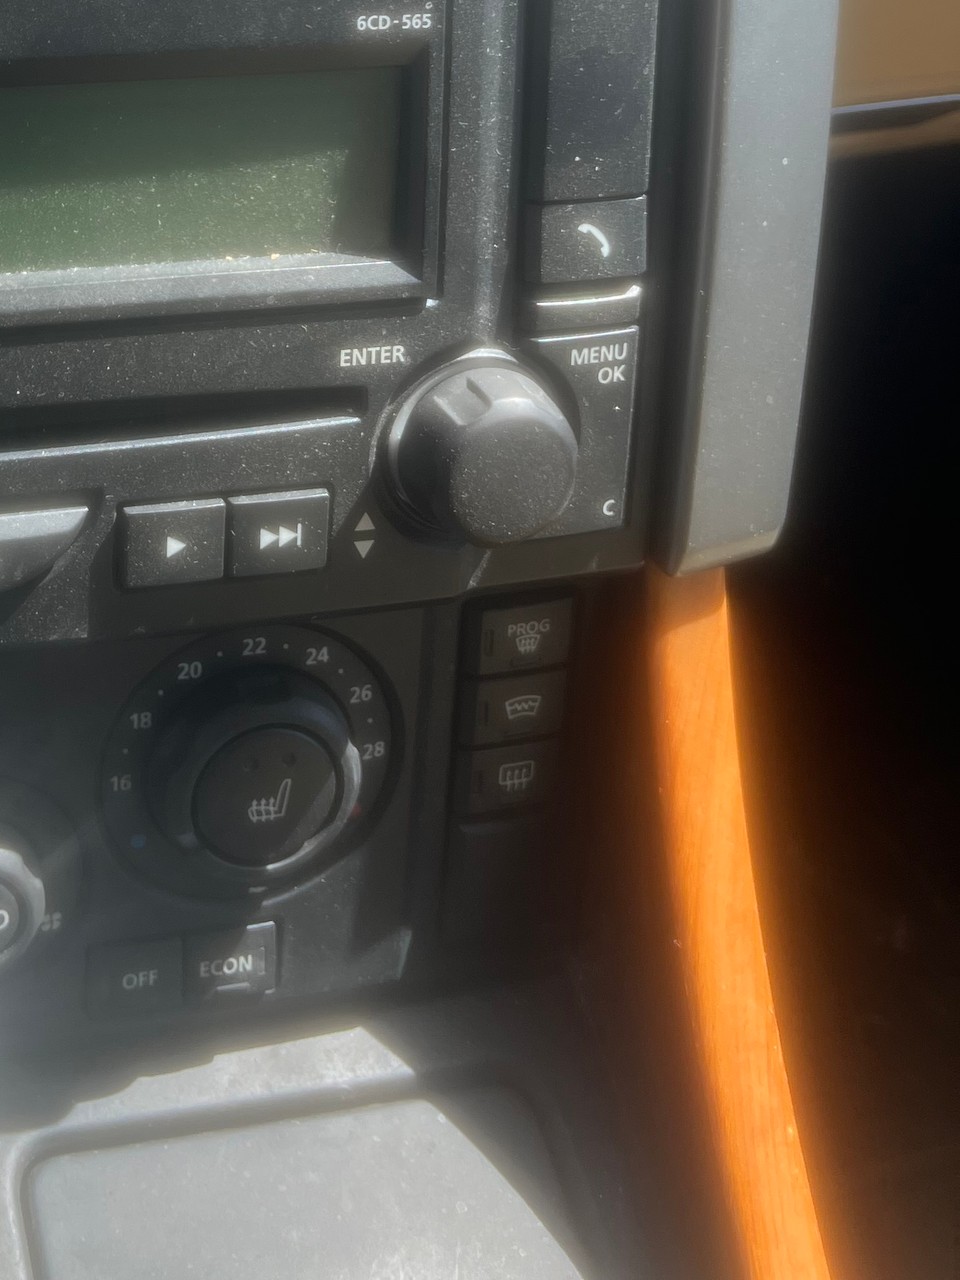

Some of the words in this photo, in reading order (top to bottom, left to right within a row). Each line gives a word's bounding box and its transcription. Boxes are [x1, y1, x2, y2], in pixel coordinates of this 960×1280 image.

[339, 345, 405, 368] ENTER
[570, 342, 628, 365] MENU
[597, 366, 626, 384] OK
[602, 499, 615, 516] C
[507, 620, 550, 637] PROG
[242, 638, 267, 656] 22
[305, 646, 329, 666] 24
[176, 662, 203, 680] 20
[349, 685, 372, 704] 26
[130, 712, 152, 729] 18
[362, 741, 386, 760] 28
[109, 775, 132, 792] 16
[199, 955, 253, 978] ECON
[122, 970, 158, 990] OFF
